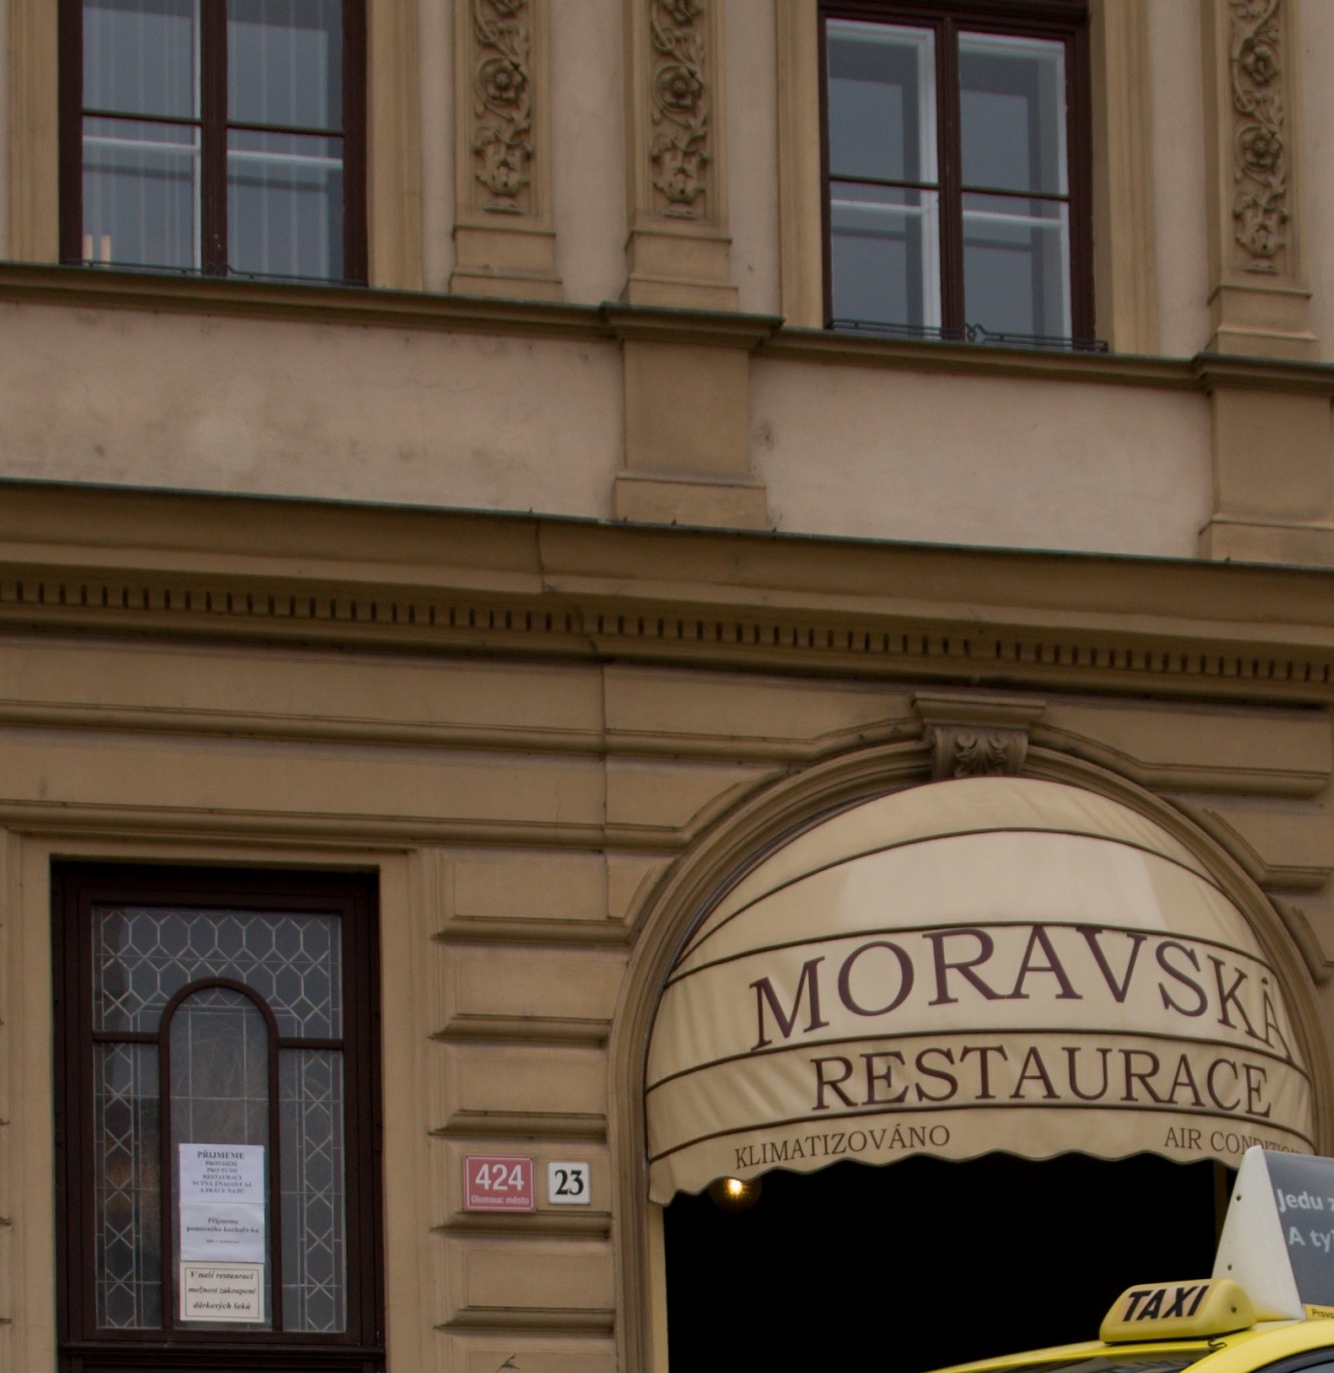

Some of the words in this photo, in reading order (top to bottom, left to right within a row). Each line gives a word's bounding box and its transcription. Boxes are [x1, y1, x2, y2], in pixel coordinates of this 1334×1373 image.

[748, 924, 1294, 1062] MORAVSKÁ
[810, 1044, 1272, 1117] RESTAURACE
[734, 1123, 951, 1170] KLIMATIZOVÁNO
[1164, 1126, 1202, 1150] AIR
[1210, 1130, 1303, 1155] CONDIT
[475, 1163, 524, 1191] 424
[554, 1169, 584, 1196] 23
[1276, 1188, 1324, 1212] Jedu
[1288, 1227, 1305, 1246] A
[1122, 1285, 1210, 1322] TAXI
